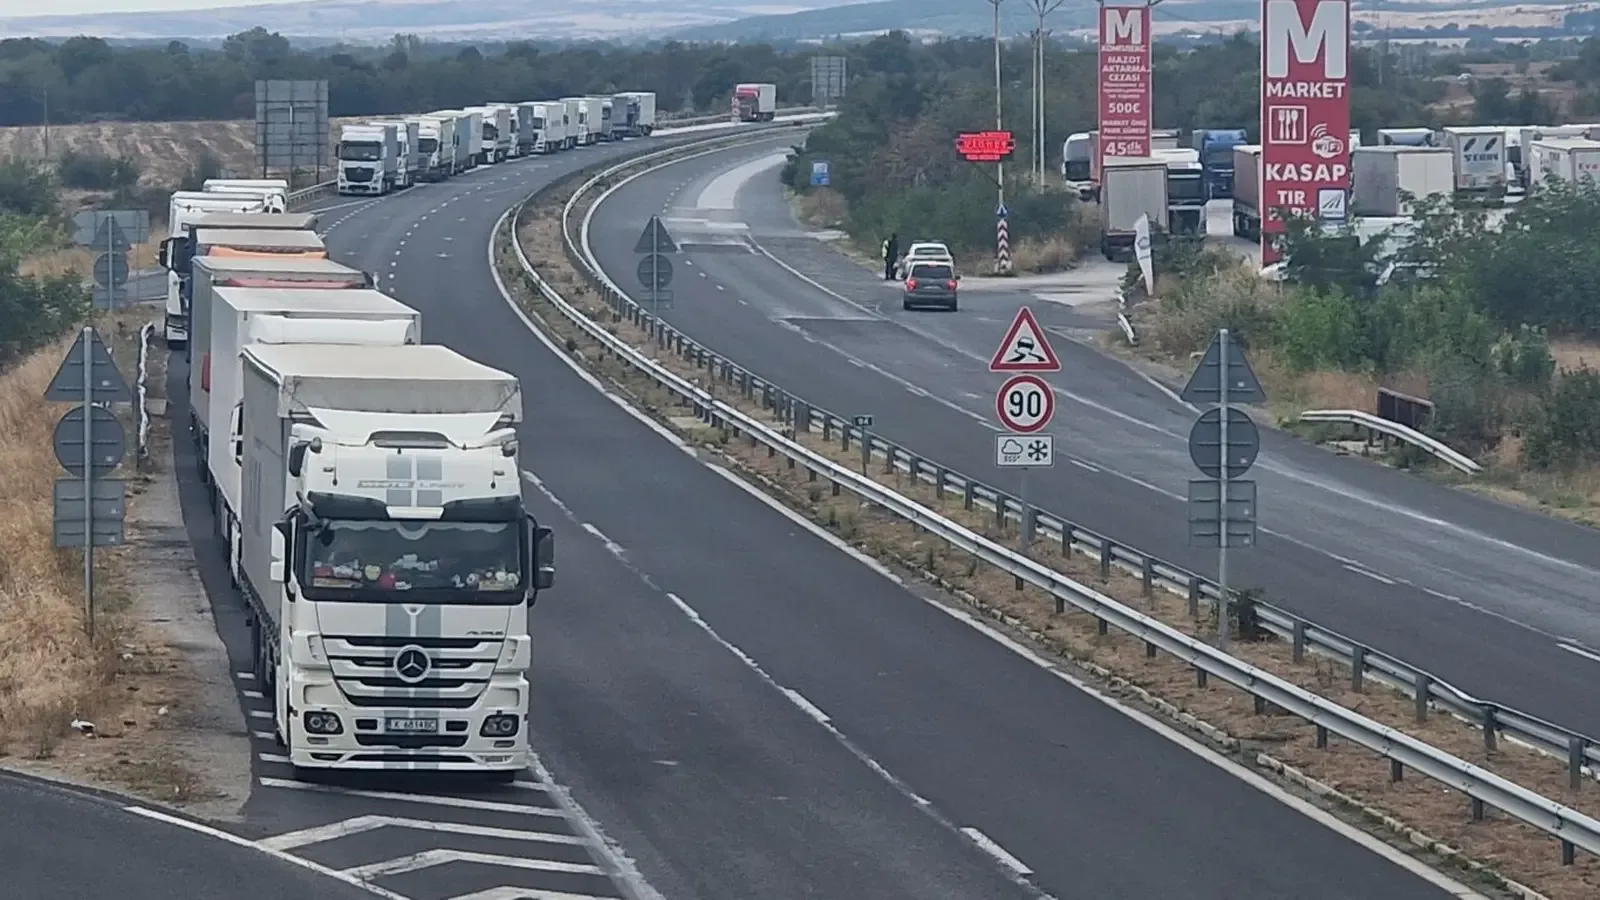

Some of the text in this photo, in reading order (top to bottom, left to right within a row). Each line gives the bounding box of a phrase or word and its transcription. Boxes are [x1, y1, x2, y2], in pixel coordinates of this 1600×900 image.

[1105, 9, 1142, 45] M
[1267, 1, 1346, 78] M
[1266, 82, 1346, 97] MARKET
[1265, 163, 1346, 181] KASAP
[1277, 190, 1305, 204] TIR
[1009, 391, 1041, 417] 90
